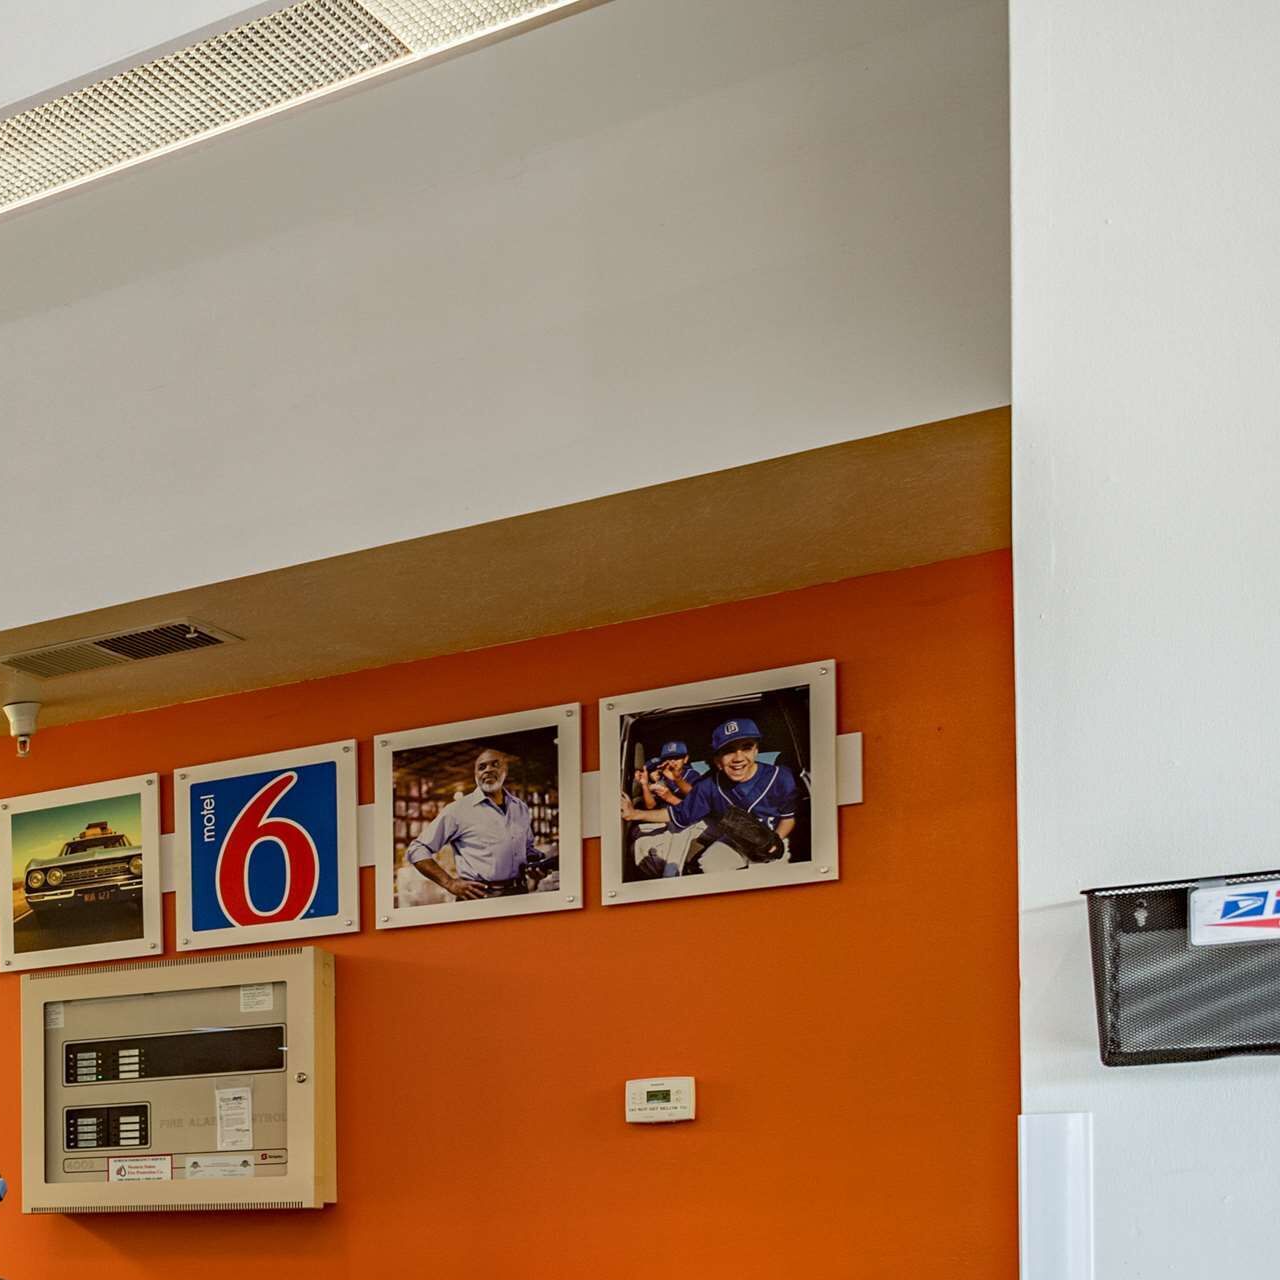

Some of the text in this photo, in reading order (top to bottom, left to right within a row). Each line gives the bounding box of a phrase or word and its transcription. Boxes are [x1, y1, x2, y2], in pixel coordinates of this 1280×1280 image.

[200, 794, 216, 842] motel
[215, 771, 320, 927] 6
[159, 1118, 184, 1128] FIRE
